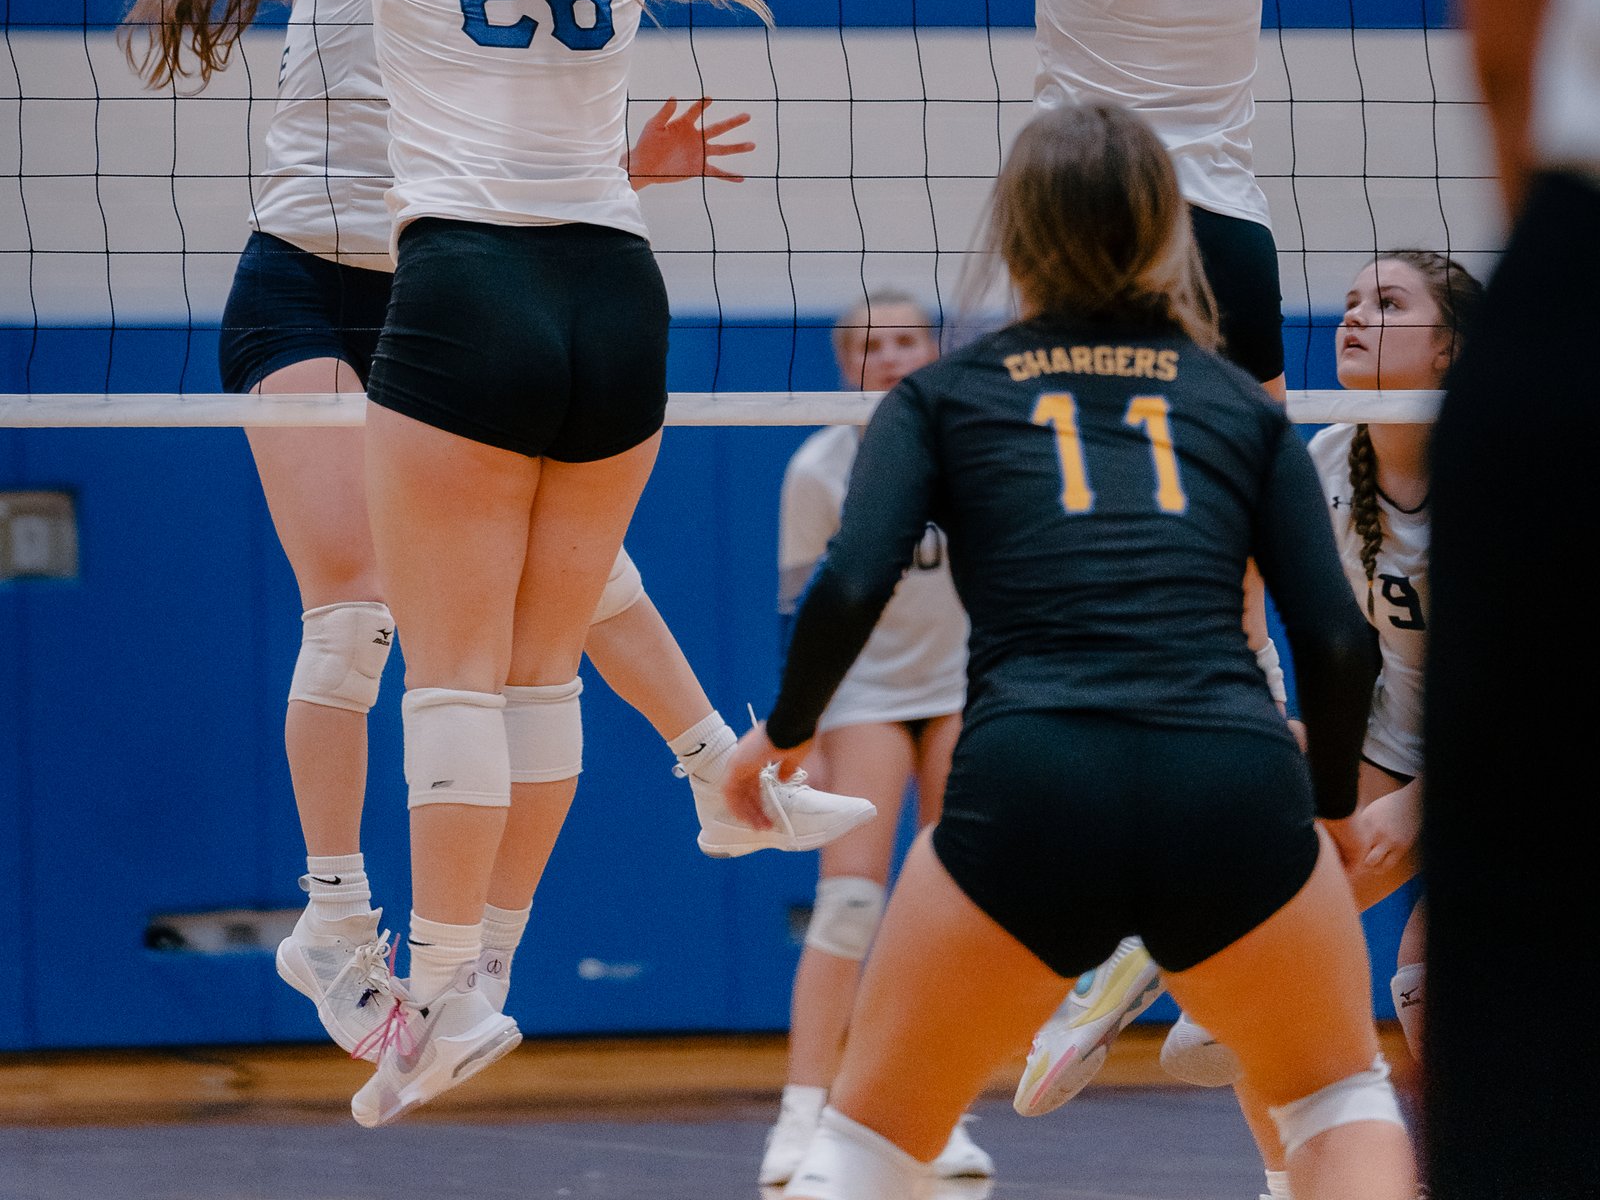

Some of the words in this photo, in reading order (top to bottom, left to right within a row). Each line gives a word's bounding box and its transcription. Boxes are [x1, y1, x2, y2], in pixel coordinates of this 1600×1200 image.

[1003, 345, 1180, 382] CHARGERS
[1031, 391, 1188, 513] 11
[1377, 573, 1425, 630] 9
